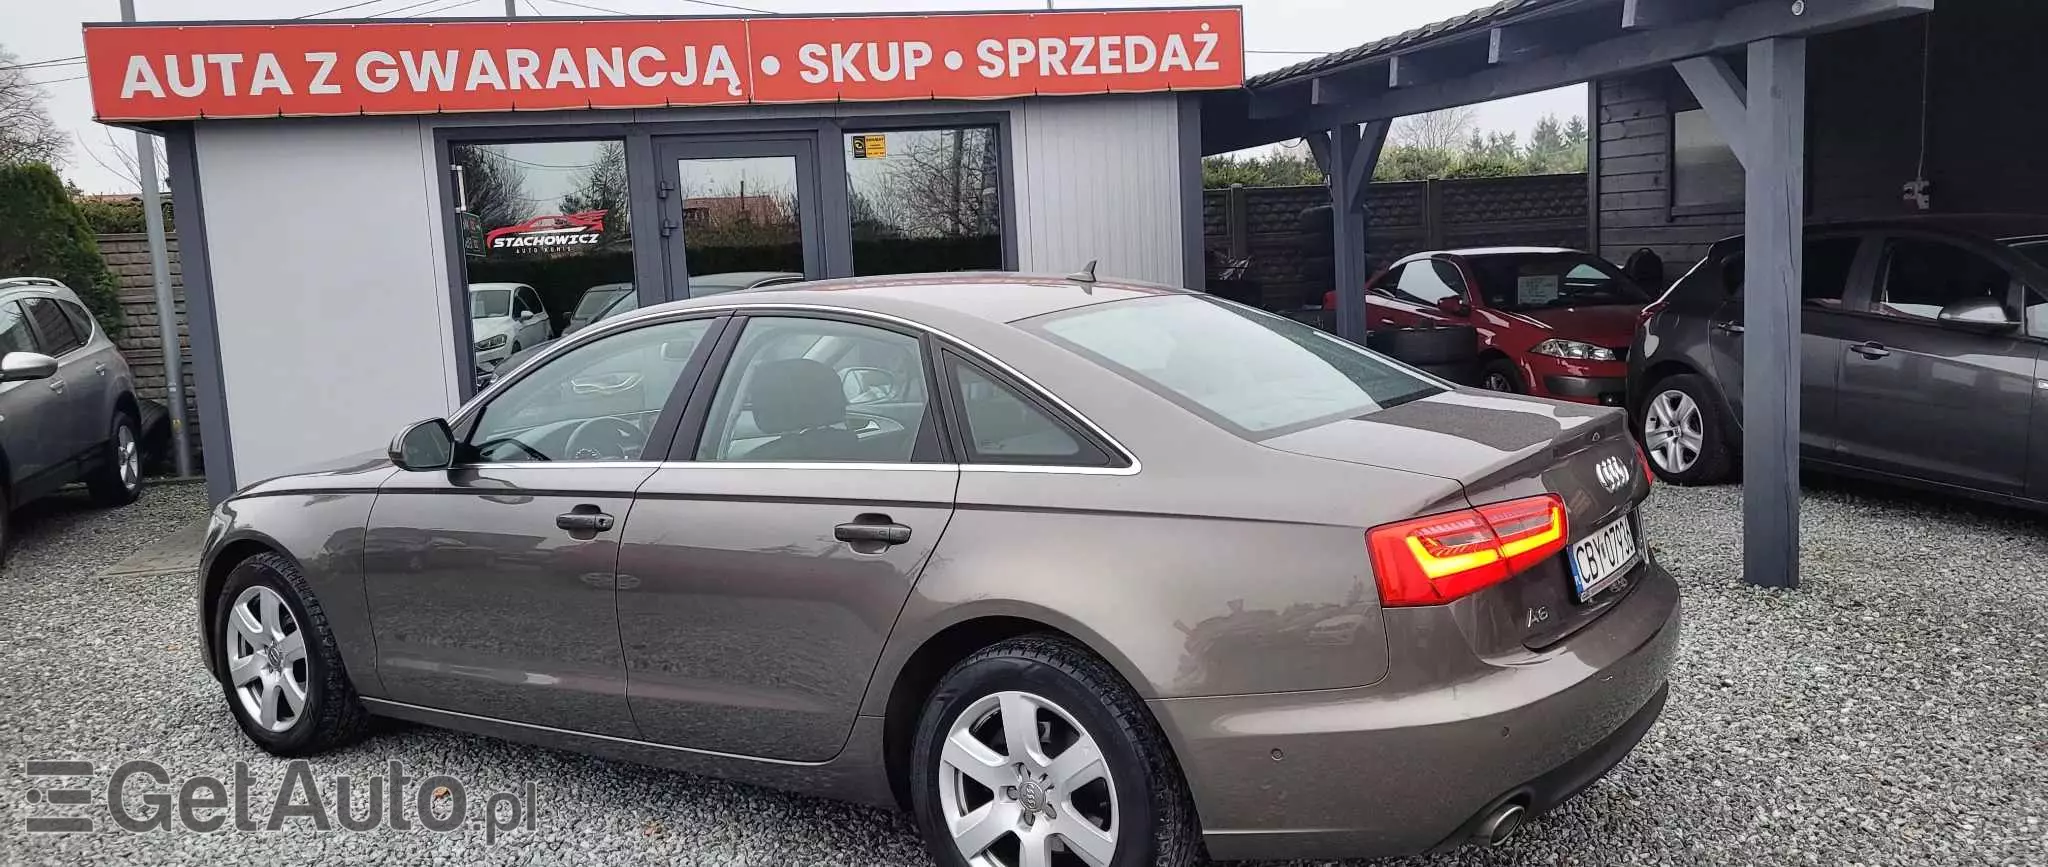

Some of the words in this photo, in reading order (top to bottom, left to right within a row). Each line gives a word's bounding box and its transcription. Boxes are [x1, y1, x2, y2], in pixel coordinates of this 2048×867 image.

[120, 52, 295, 99] AUTA
[304, 51, 343, 95] Z
[355, 44, 743, 97] GWARANCJĄ
[798, 41, 933, 84] SKUP
[976, 22, 1220, 79] SPRZEDAŻ
[493, 233, 600, 248] STACHOWICZ
[1576, 535, 1606, 584] CBY
[1527, 606, 1549, 628] A6
